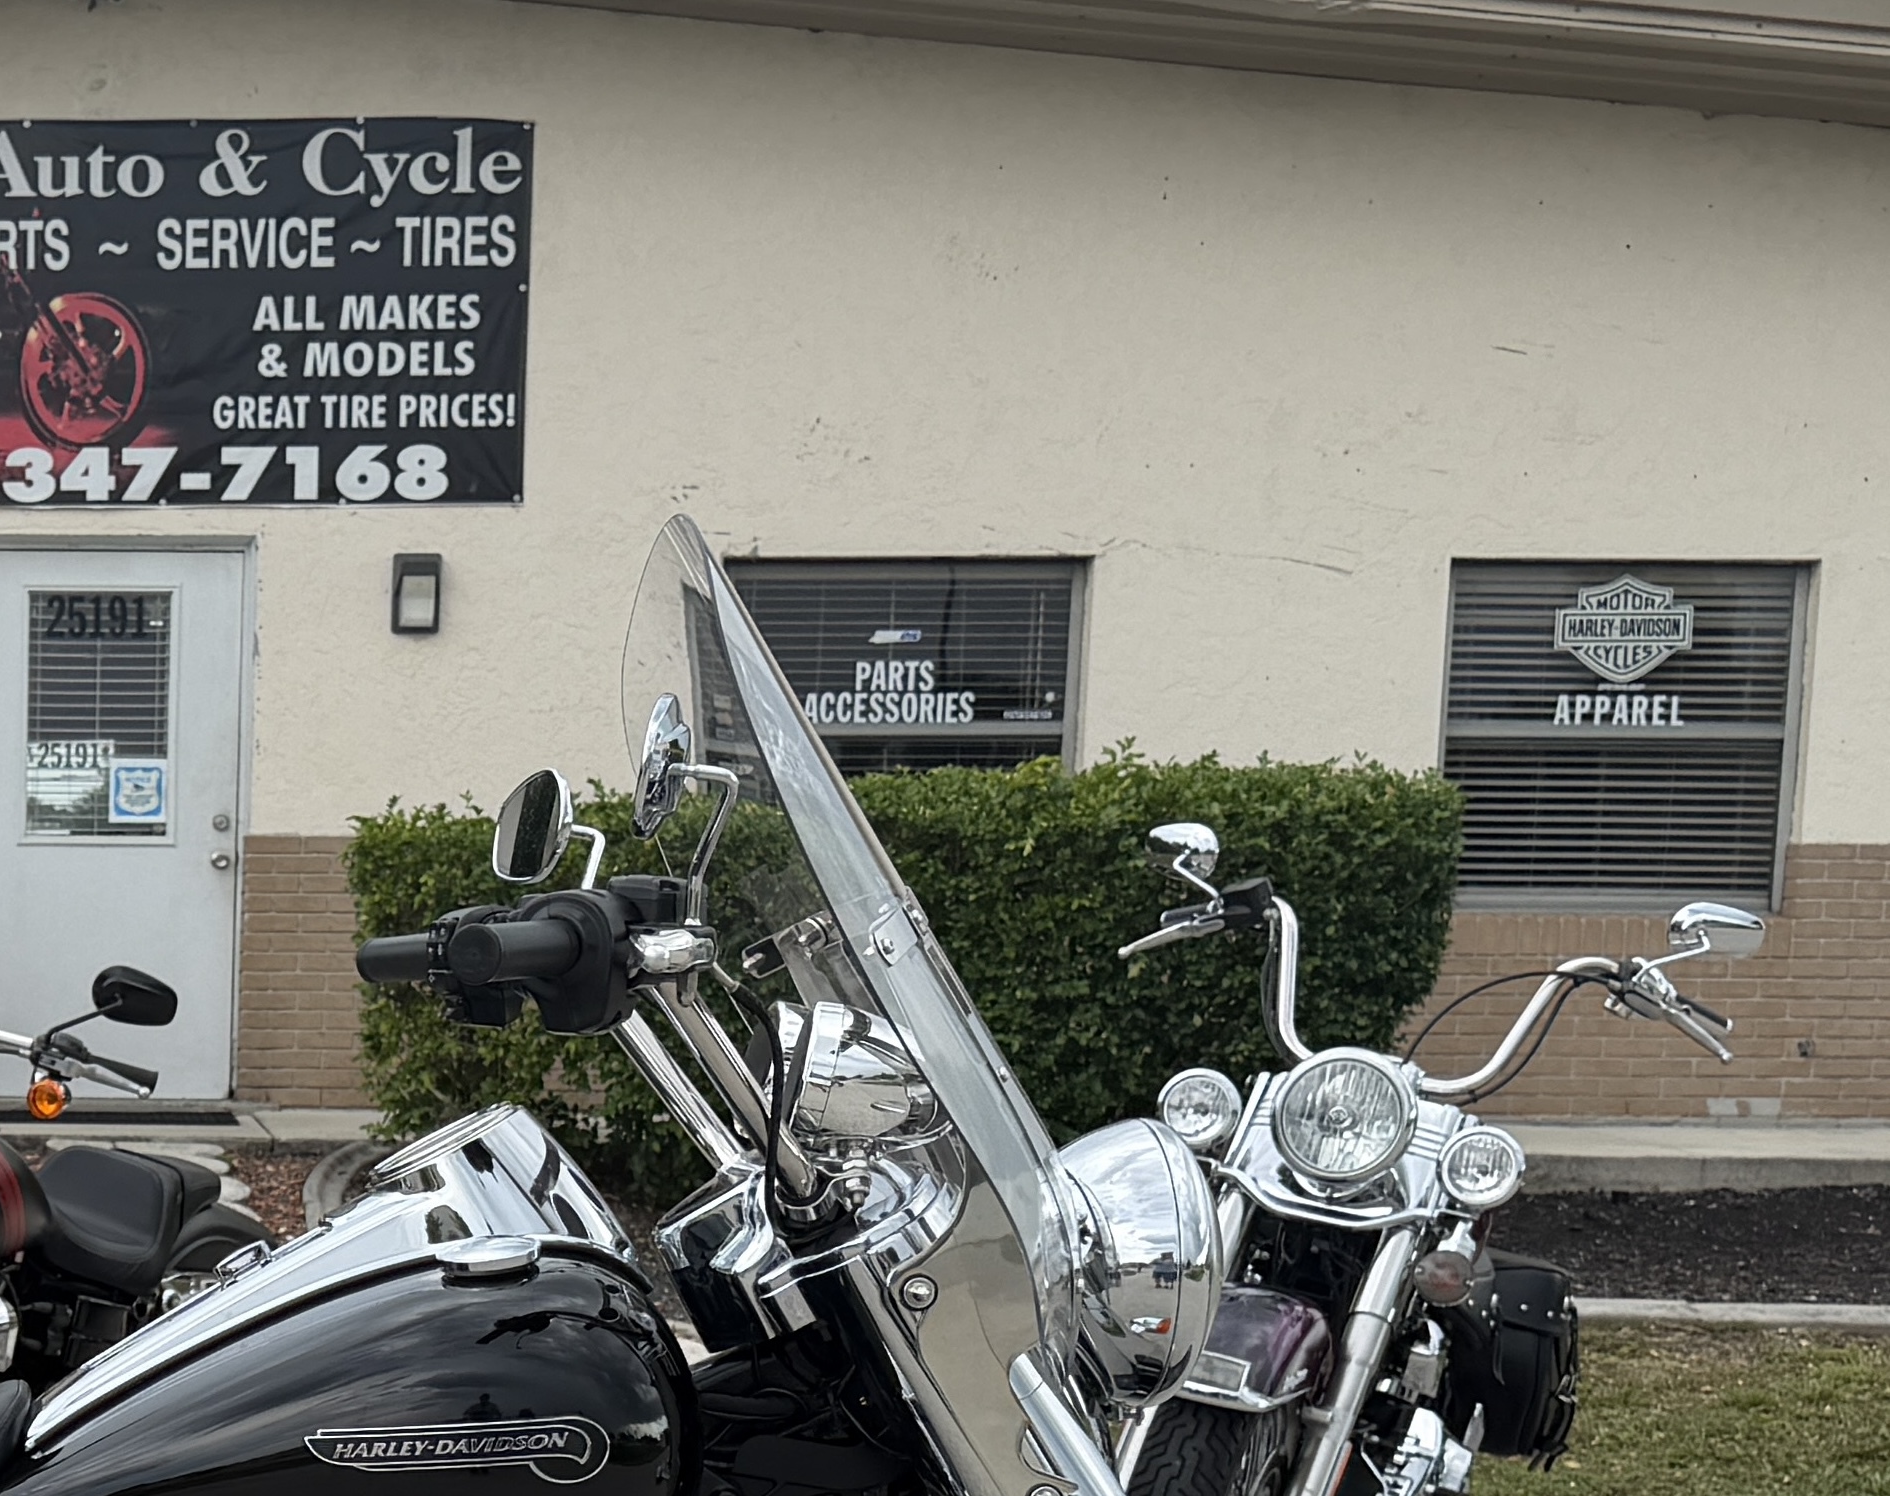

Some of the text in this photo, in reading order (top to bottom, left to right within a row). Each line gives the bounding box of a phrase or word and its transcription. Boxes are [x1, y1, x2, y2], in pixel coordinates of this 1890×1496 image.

[199, 127, 267, 197] &
[301, 126, 522, 207] Cycle
[156, 215, 335, 271] SERVICE
[395, 214, 516, 269] TIRES
[252, 293, 482, 332] ALL MAKES
[257, 340, 476, 378] & MODELS
[212, 393, 516, 430] GREAT TIRE PRICES!
[1596, 589, 1655, 611] MOTOR
[46, 594, 147, 639] 25191
[1568, 618, 1681, 638] HARLEY-DAVIDSON
[1593, 645, 1653, 669] CYCLES
[855, 660, 935, 692] PARTS
[805, 691, 976, 724] ACCESSORIES
[1553, 694, 1684, 726] APPAREL
[37, 742, 100, 768] 25191
[332, 1432, 570, 1460] HARLEY-DAVIDSON
